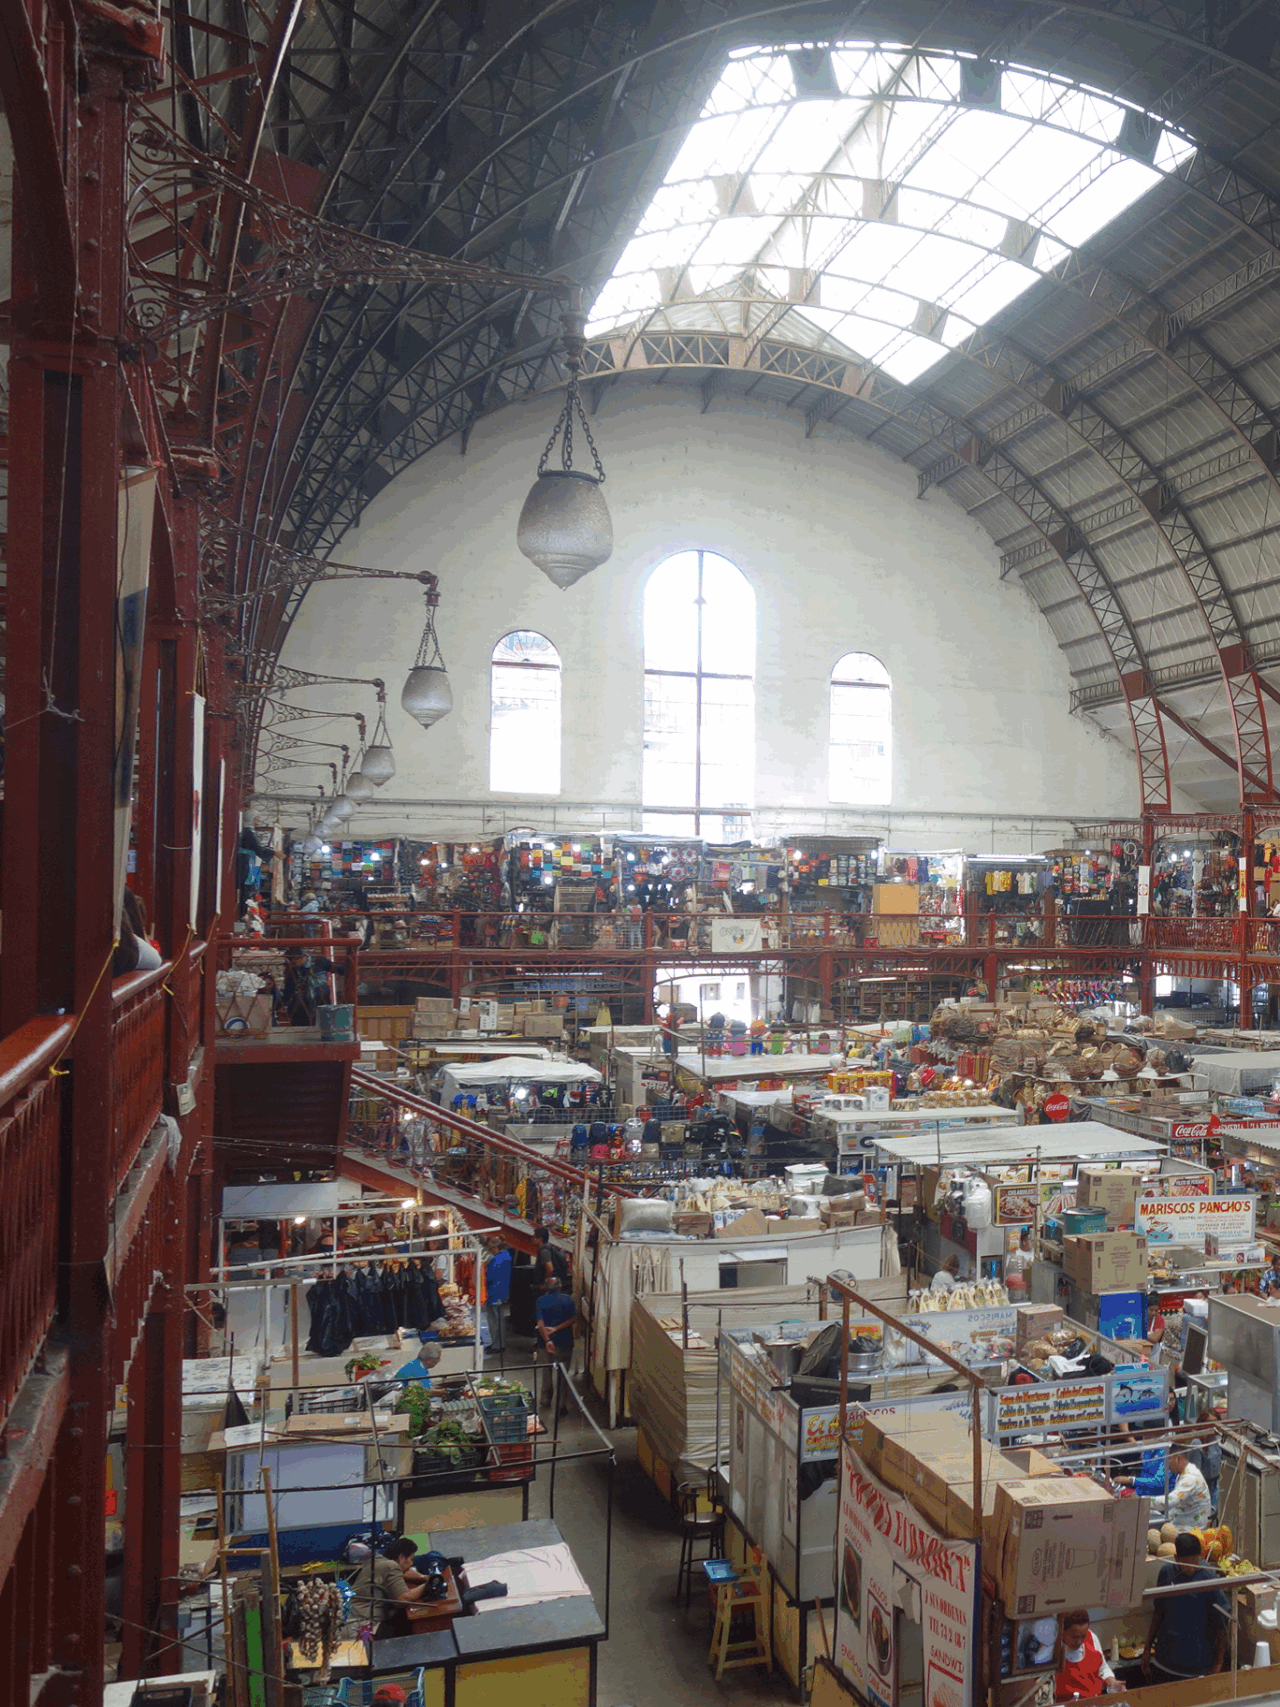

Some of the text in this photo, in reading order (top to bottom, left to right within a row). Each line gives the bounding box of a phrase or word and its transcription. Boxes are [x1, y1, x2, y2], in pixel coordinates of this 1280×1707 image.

[1175, 1123, 1209, 1138] Coca-Cola
[1140, 1200, 1251, 1215] MARISCOS PANCHO'S
